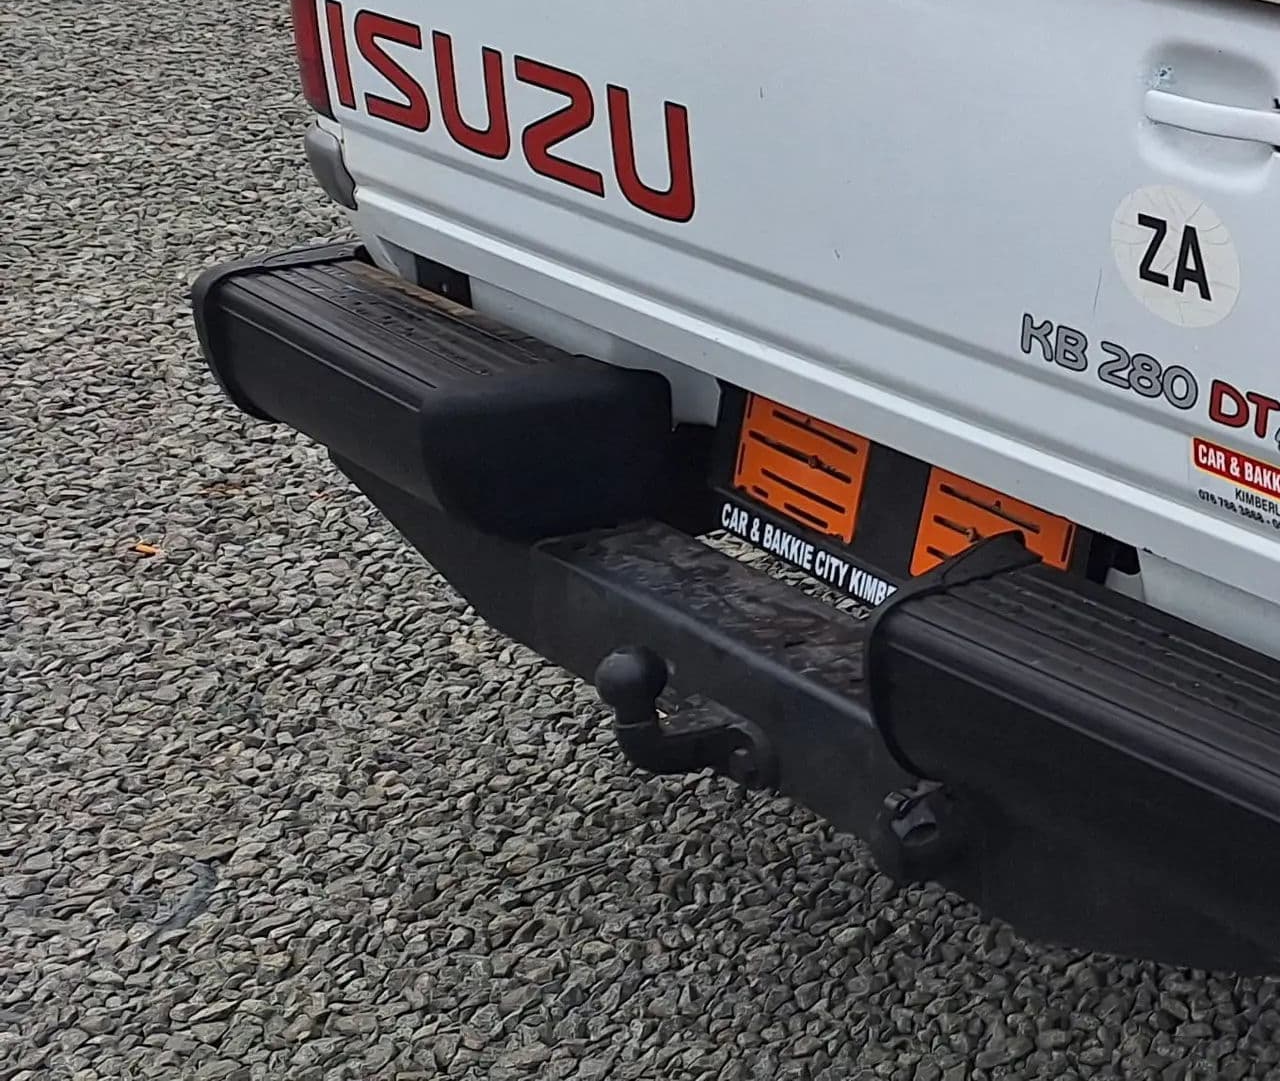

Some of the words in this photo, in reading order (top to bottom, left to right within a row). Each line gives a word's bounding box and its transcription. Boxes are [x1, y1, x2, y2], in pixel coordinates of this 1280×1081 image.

[1137, 213, 1212, 302] ZA
[1020, 313, 1088, 371] KB
[1098, 341, 1198, 410] 280
[1198, 444, 1226, 472] CAR
[1230, 457, 1241, 477] &
[721, 503, 750, 538] CAR
[750, 518, 761, 542] &
[763, 523, 813, 572] BAKKIE
[814, 551, 850, 587] CITY
